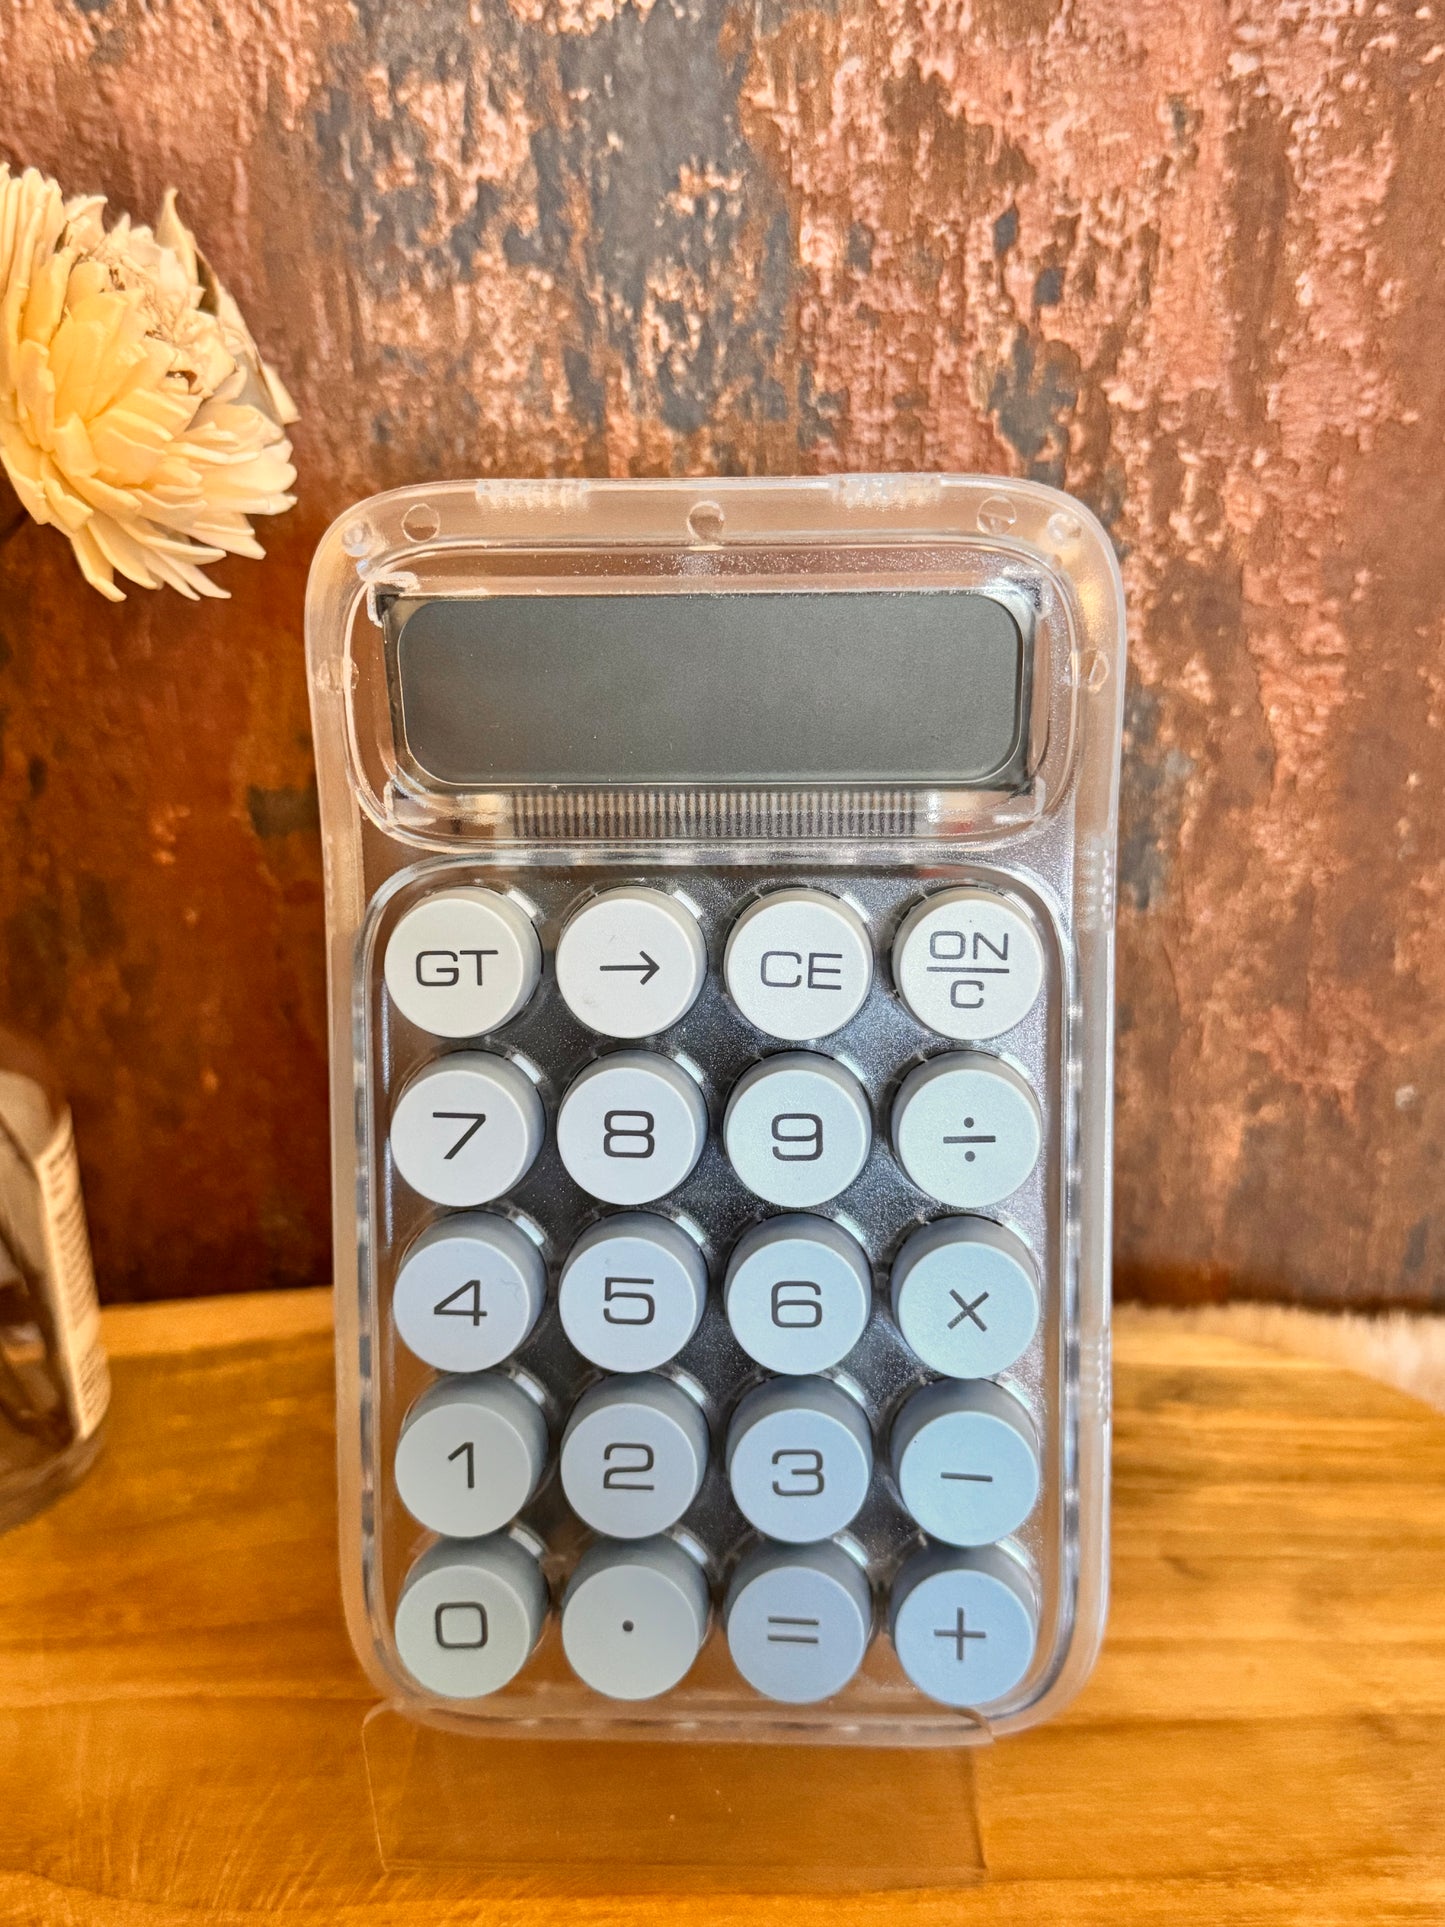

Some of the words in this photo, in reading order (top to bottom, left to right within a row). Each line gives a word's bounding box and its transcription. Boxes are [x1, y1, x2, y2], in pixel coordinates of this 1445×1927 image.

[415, 949, 499, 987] GT
[929, 930, 1009, 961] ON
[760, 950, 843, 991] CE
[950, 979, 985, 1009] C
[432, 1111, 487, 1160] 7
[603, 1109, 656, 1159] 8
[771, 1112, 824, 1162] 9
[433, 1279, 488, 1327] 4
[603, 1276, 656, 1326] 5
[770, 1280, 823, 1329] 6
[447, 1441, 475, 1489] 1
[602, 1442, 655, 1491] 2
[771, 1449, 825, 1497] 3
[434, 1601, 489, 1650] 0
